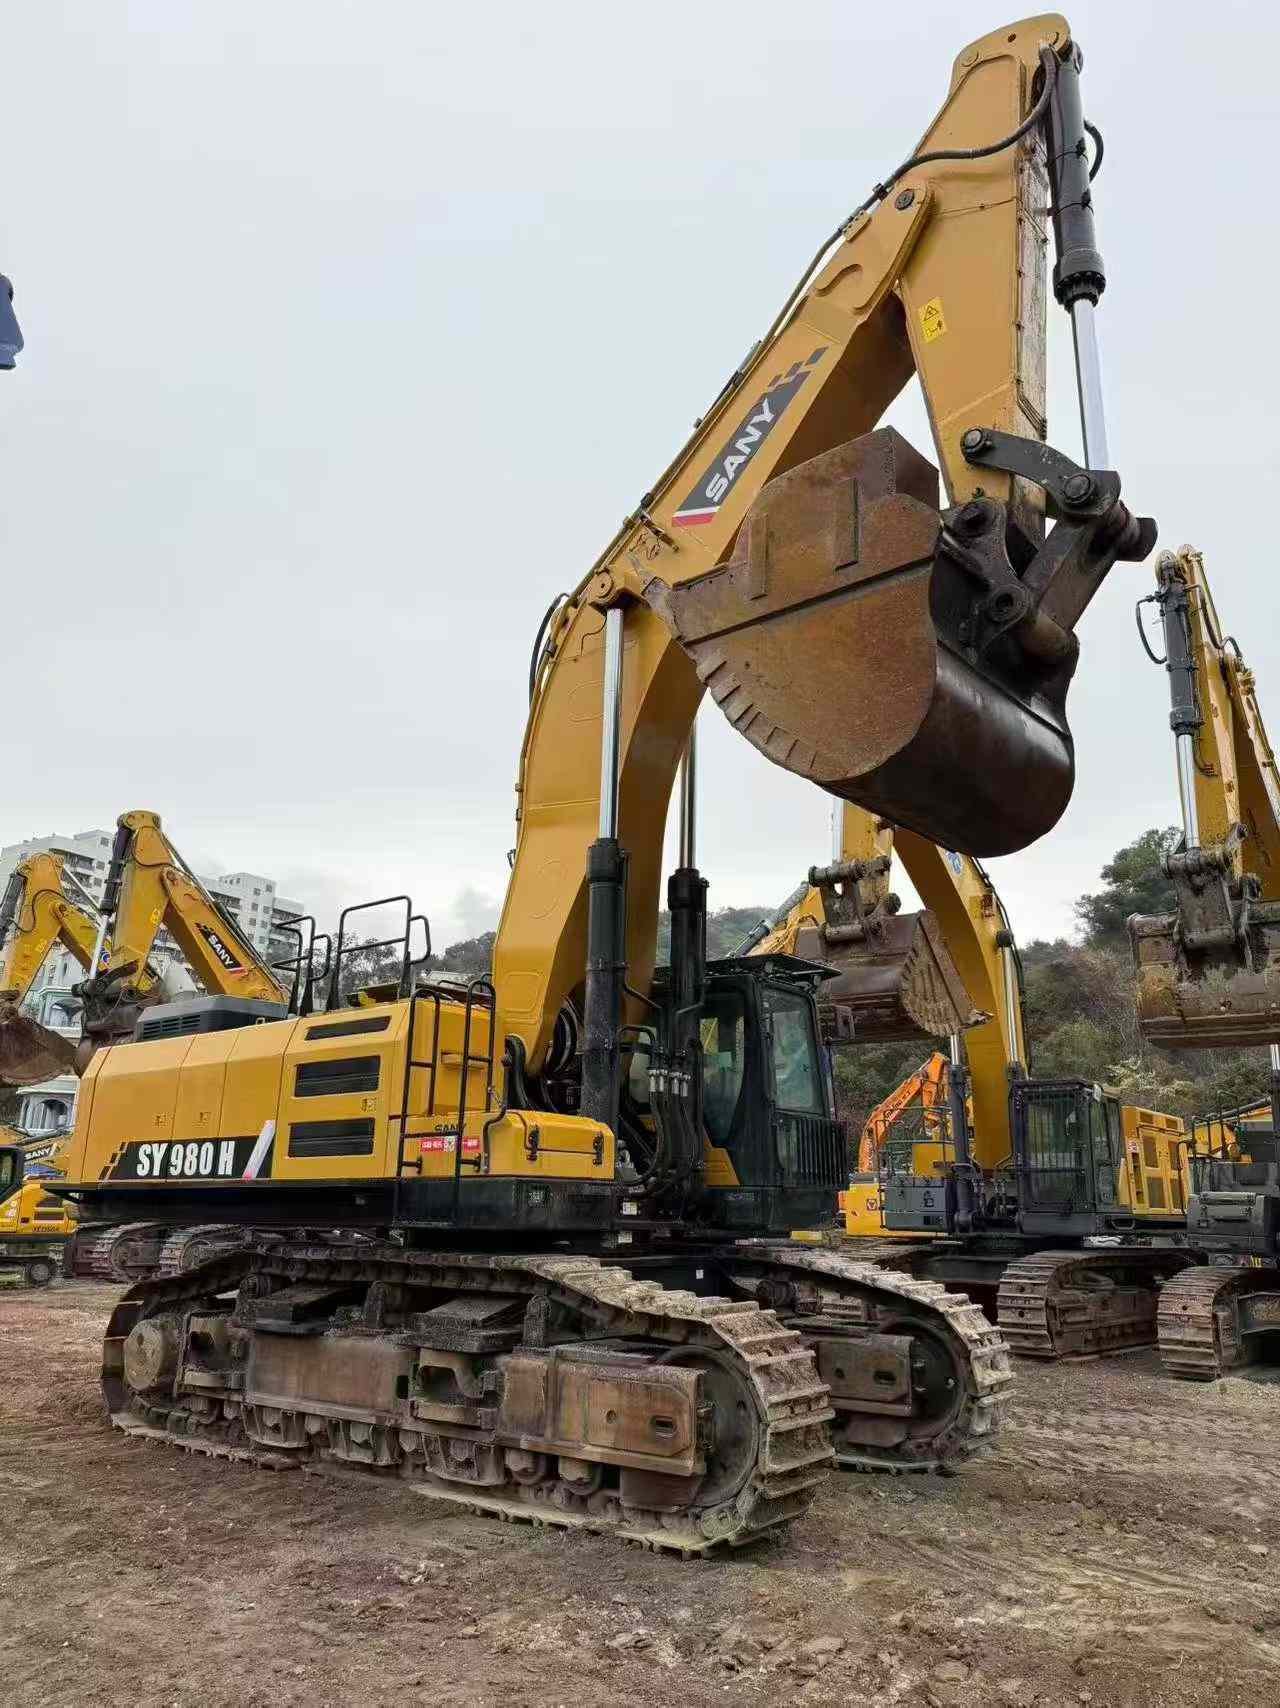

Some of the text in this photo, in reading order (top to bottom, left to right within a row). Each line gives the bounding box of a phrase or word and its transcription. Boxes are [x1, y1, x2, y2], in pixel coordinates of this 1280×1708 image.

[705, 398, 775, 503] SANY
[208, 934, 235, 965] SANY
[24, 1146, 52, 1160] SANY
